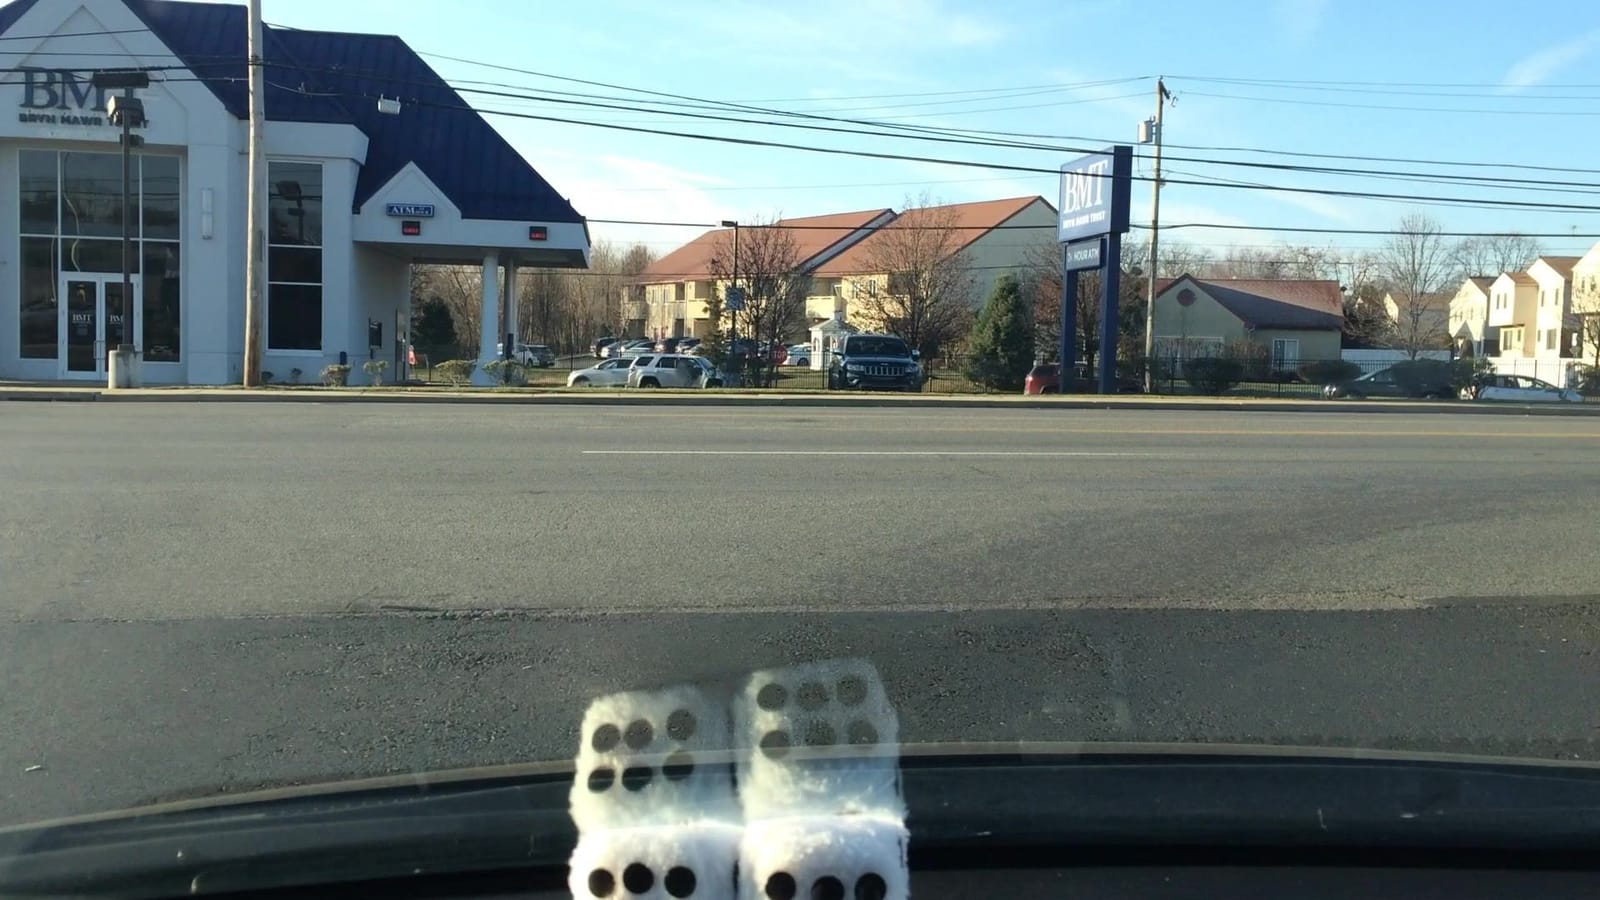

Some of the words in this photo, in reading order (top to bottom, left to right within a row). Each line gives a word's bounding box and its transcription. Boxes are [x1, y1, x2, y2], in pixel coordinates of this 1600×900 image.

[19, 69, 148, 112] BM
[61, 115, 102, 126] MAWR
[1063, 159, 1108, 214] BMT
[391, 205, 415, 215] ATM
[1074, 249, 1088, 261] HOUR
